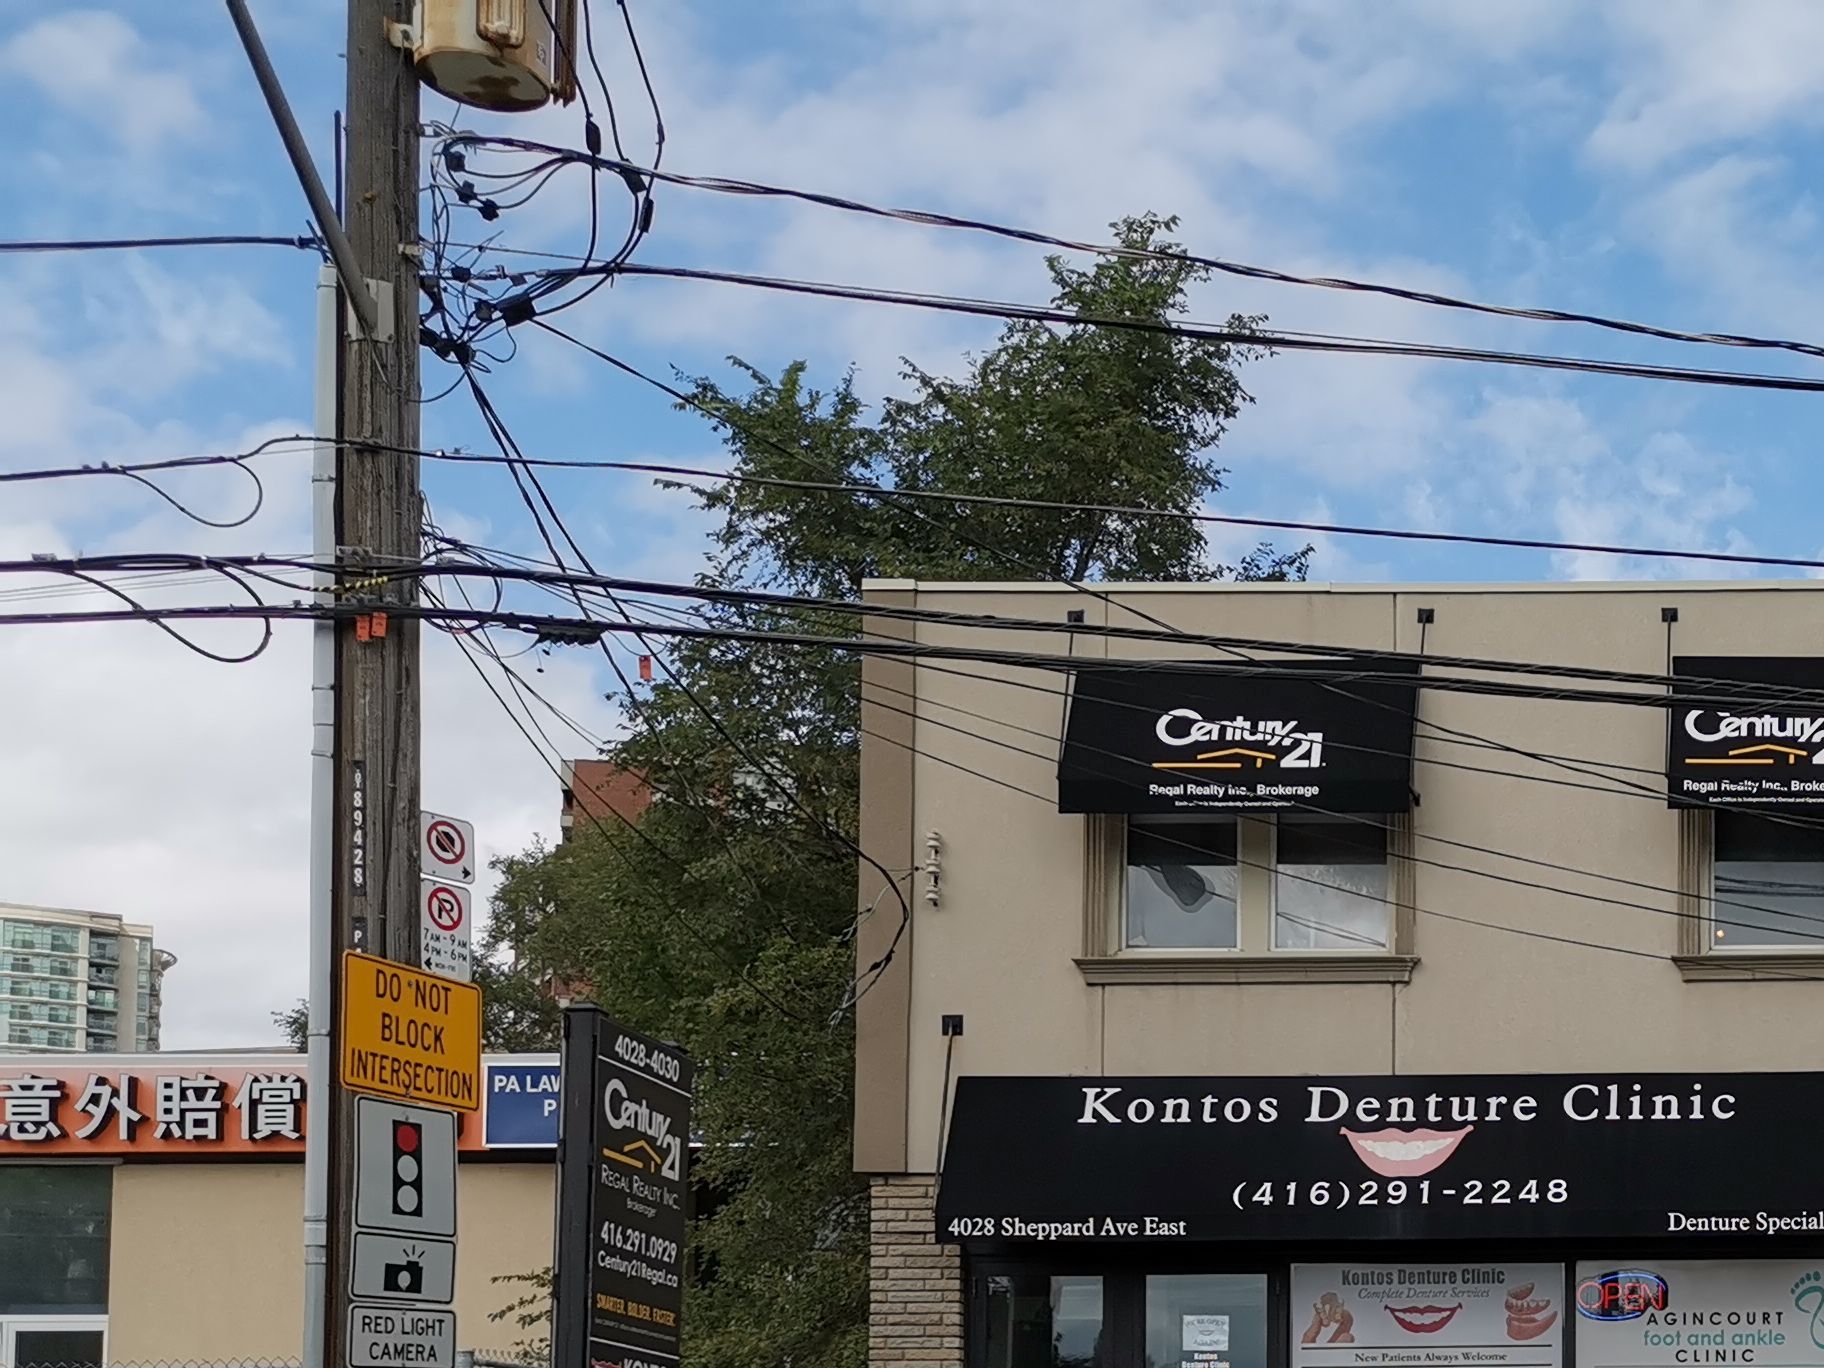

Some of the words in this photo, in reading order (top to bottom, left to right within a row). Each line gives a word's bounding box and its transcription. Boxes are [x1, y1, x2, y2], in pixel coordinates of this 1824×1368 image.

[1156, 708, 1299, 746] Century
[1280, 732, 1324, 768] 21
[1149, 783, 1184, 797] Regal
[1187, 783, 1226, 798] Realty
[1256, 783, 1320, 798] Brokerage
[1683, 779, 1718, 793] Regal
[1721, 779, 1760, 794] Realty
[375, 969, 402, 1001] DO
[414, 980, 452, 1016] NOT
[380, 1018, 445, 1056] BLOCK
[614, 1034, 680, 1082] 4028-4030
[350, 1050, 474, 1103] INTERSECTION
[494, 1074, 521, 1093] PA
[0, 1073, 302, 1142] 意外賠償
[1077, 1086, 1280, 1124] Kontos
[1304, 1085, 1538, 1123] Denture
[1563, 1082, 1737, 1122] Clinic
[604, 1078, 671, 1147] Century
[660, 1133, 682, 1182] 21
[1232, 1178, 1570, 1210] (416)291-2248
[948, 1217, 995, 1237] 4028
[1001, 1216, 1095, 1240] Sheppard
[1100, 1217, 1139, 1236] Ave
[1143, 1216, 1187, 1236] East
[1668, 1211, 1750, 1232] Denture
[600, 1220, 677, 1264] 416.291.0929
[597, 1250, 679, 1288] Century21Regal.ca
[1341, 1269, 1394, 1286] Kontos
[1398, 1268, 1458, 1285] Denture
[1461, 1268, 1506, 1285] Clinic
[1358, 1287, 1403, 1302] Complete
[1406, 1287, 1448, 1299] Denture
[1450, 1286, 1490, 1298] Services
[1576, 1281, 1664, 1311] OPEN
[361, 1315, 395, 1337] RED
[400, 1317, 445, 1339] LIGHT
[1646, 1312, 1784, 1326] AGINCOURT
[1643, 1330, 1681, 1346] foot
[1687, 1330, 1725, 1346] and
[1731, 1329, 1786, 1346] ankle
[368, 1341, 439, 1364] CAMERA
[1354, 1353, 1379, 1363] New
[1381, 1352, 1421, 1363] Patients
[1424, 1352, 1459, 1364] Always
[1461, 1351, 1508, 1362] Welcome
[1675, 1349, 1755, 1363] CLINIC
